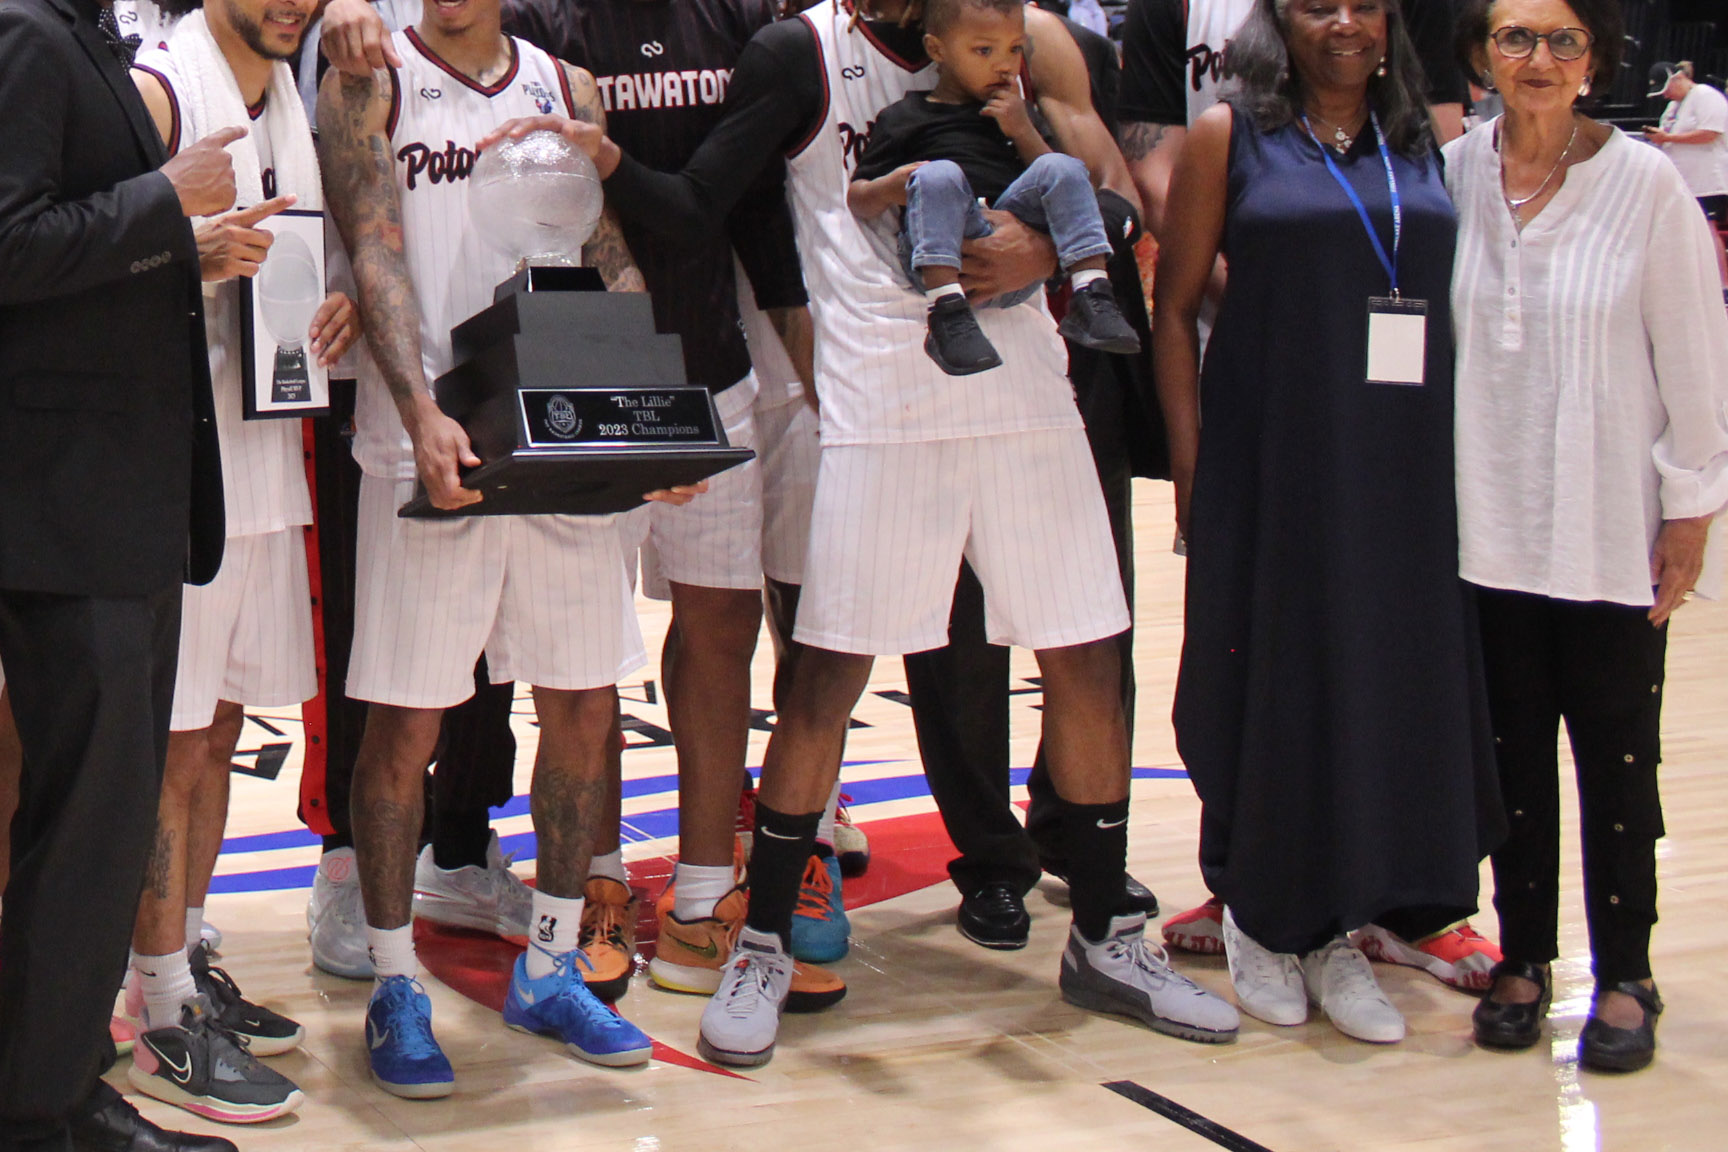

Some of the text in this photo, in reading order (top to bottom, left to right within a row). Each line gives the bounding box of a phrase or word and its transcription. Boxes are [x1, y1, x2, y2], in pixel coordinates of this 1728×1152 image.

[633, 410, 660, 422] TBL
[599, 423, 629, 436] 2023
[632, 422, 700, 438] Champions
